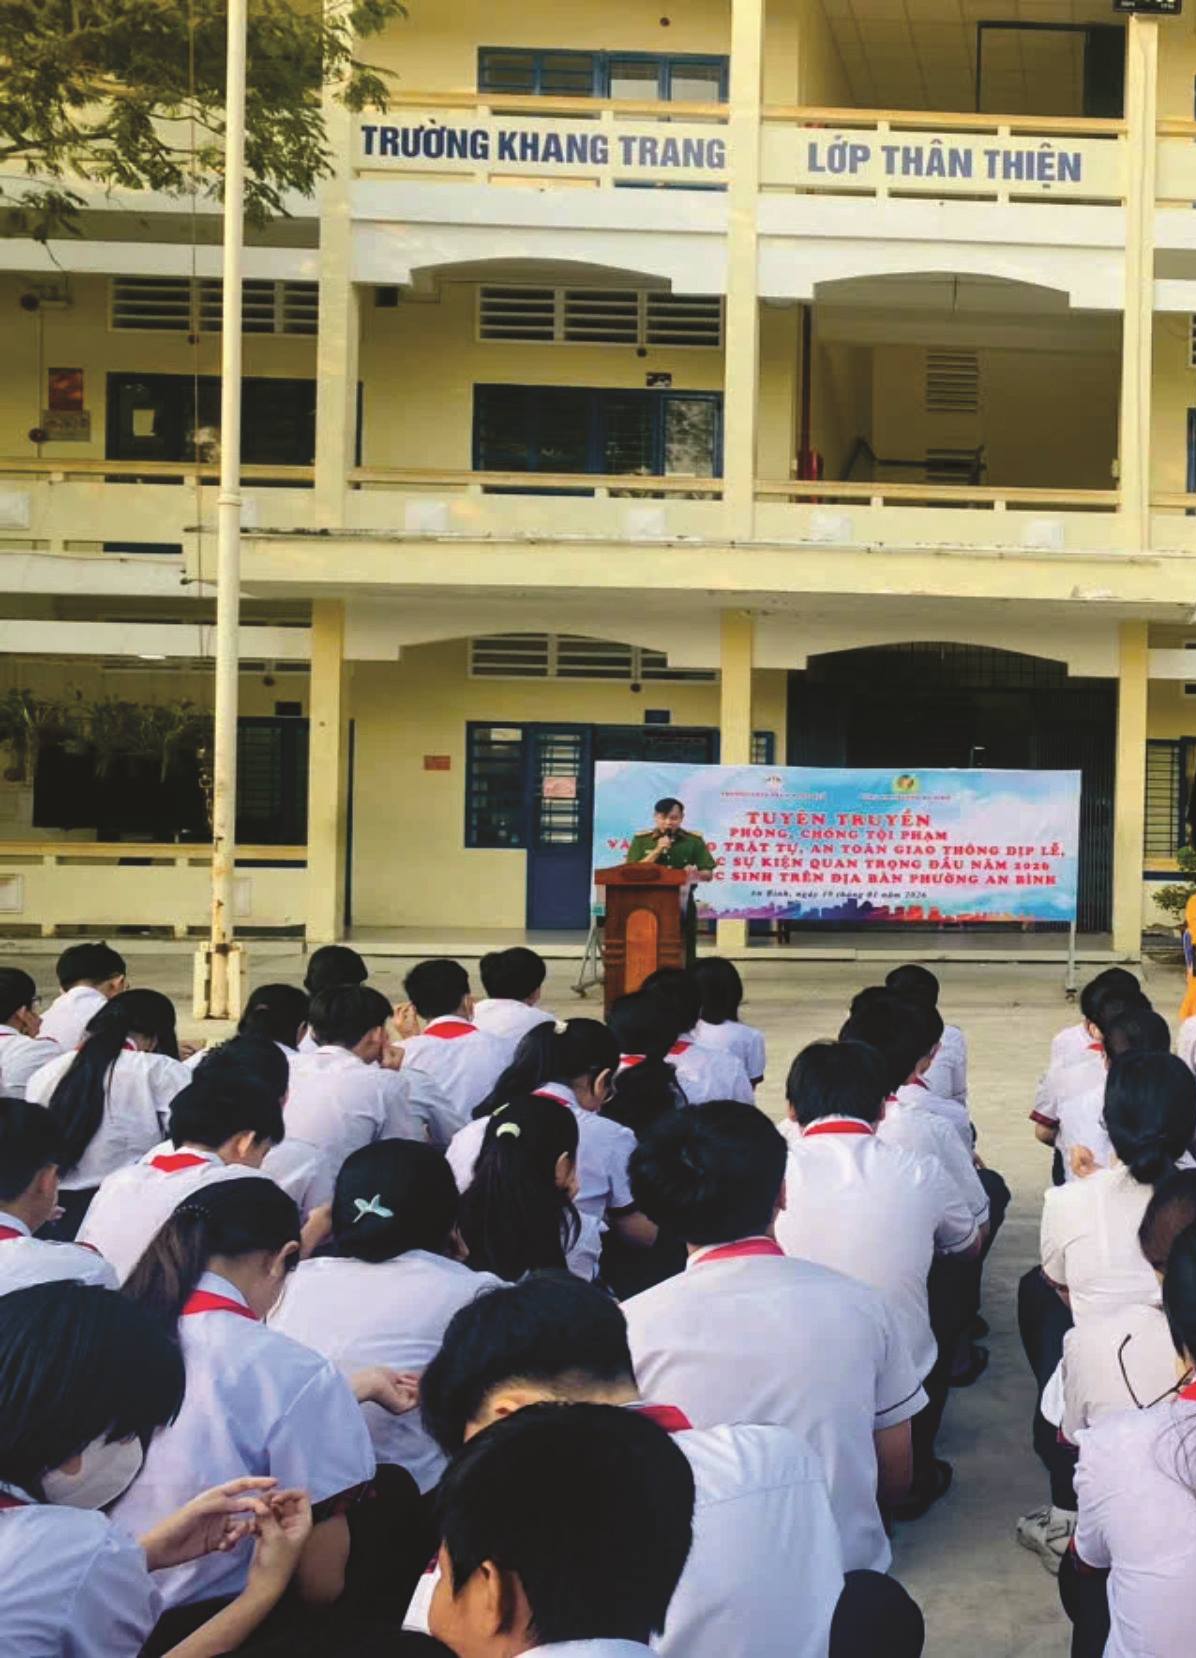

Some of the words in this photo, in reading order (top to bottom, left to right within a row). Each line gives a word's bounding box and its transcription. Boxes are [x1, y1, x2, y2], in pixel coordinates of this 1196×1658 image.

[361, 117, 489, 160] TRƯỜNG
[498, 129, 609, 165] KHANG
[619, 134, 725, 169] TRANG
[808, 138, 871, 177] LỚP
[881, 140, 973, 179] THÂN
[984, 143, 1081, 189] THIỆN
[746, 809, 826, 825] TUYÊN
[812, 843, 834, 854] AN
[894, 845, 935, 856] GIAO
[942, 844, 999, 857] THÔNG
[810, 859, 857, 870] QUAN
[731, 872, 772, 882] SINH
[985, 875, 1008, 885] AN
